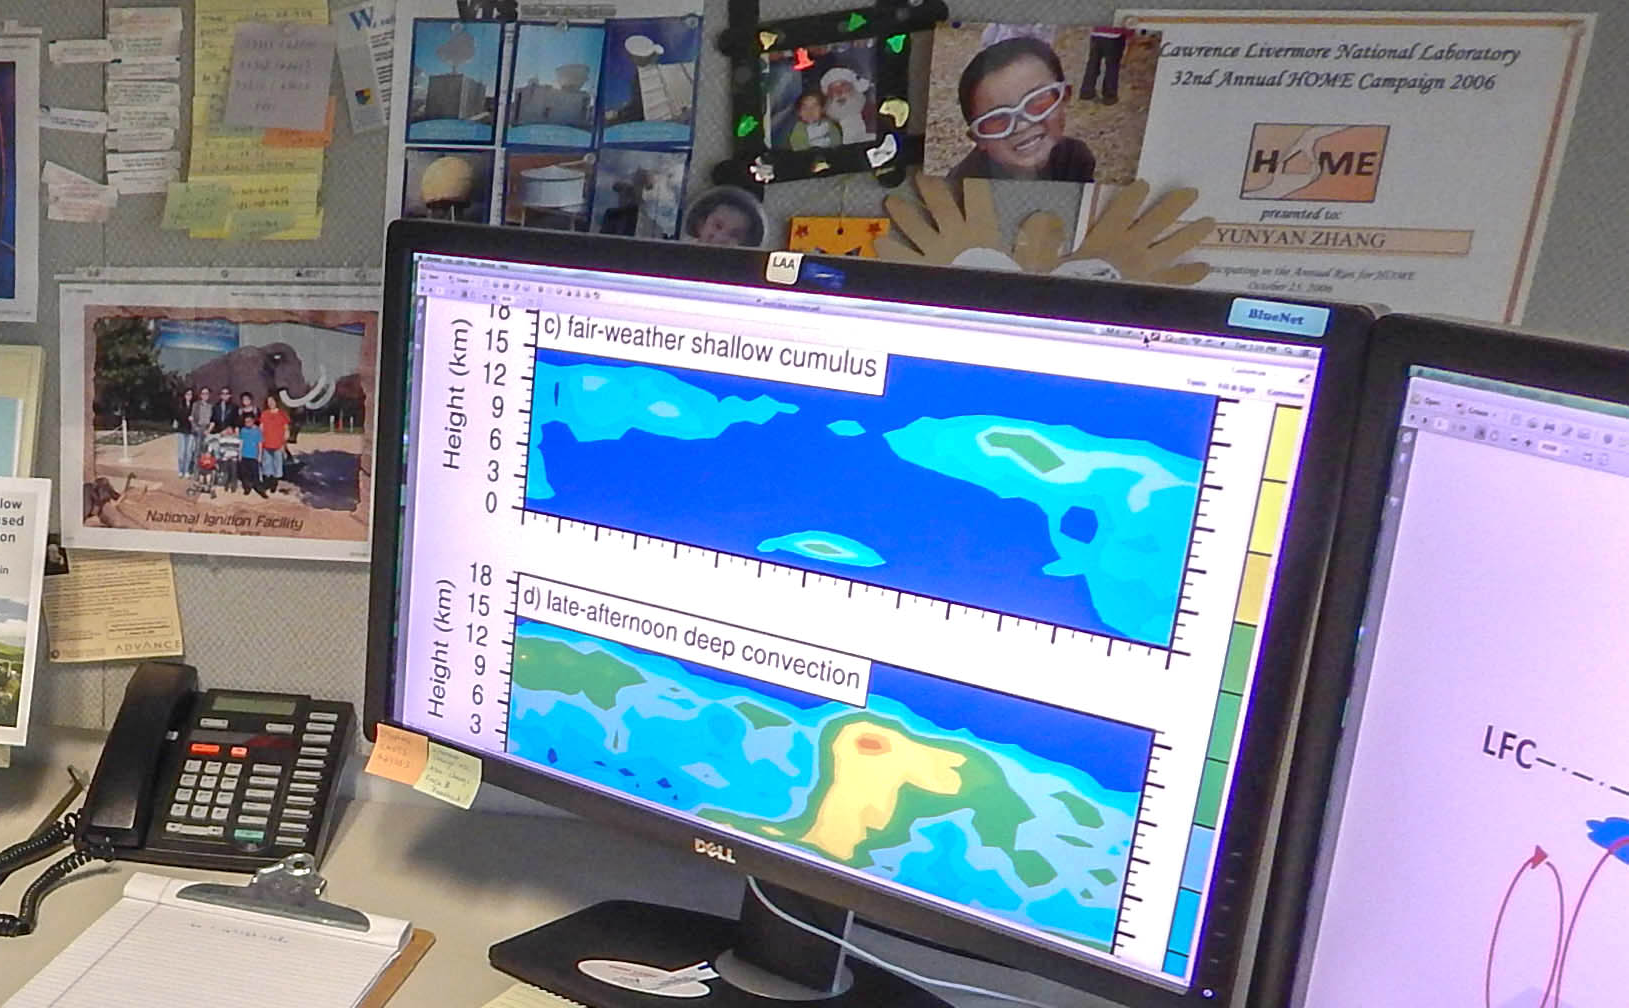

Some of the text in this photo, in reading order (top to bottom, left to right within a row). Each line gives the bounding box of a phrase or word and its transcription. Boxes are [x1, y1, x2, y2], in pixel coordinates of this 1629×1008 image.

[1160, 42, 1521, 67] Lawrence Livermore National Laboratory
[1170, 70, 1497, 95] 32nd Annual HOME Campaign 2006
[1259, 208, 1320, 221] presented
[1217, 228, 1385, 248] YUNYAN ZHANG
[772, 256, 795, 270] LAA
[1248, 308, 1304, 326] BlueNet
[485, 328, 509, 354] 15
[544, 314, 877, 377] c) fair-weather shallow cumulus
[483, 362, 507, 386] 12
[442, 318, 474, 470] Height (km)
[492, 395, 504, 419] 9
[489, 428, 502, 451] 6
[486, 460, 500, 482] 3
[485, 491, 497, 513] 0
[146, 509, 304, 531] National Ignition Facility
[469, 562, 492, 586] 18
[468, 593, 490, 617] 15
[114, 639, 181, 653] ADVANCE
[466, 623, 488, 647] 12
[523, 586, 860, 689] d) late-afternoon deep convection
[428, 578, 457, 718] Height (km)
[474, 655, 486, 676] 9
[472, 684, 484, 705] 6
[469, 713, 482, 734] 3
[1482, 724, 1537, 769] LFC
[694, 838, 736, 864] DELL
